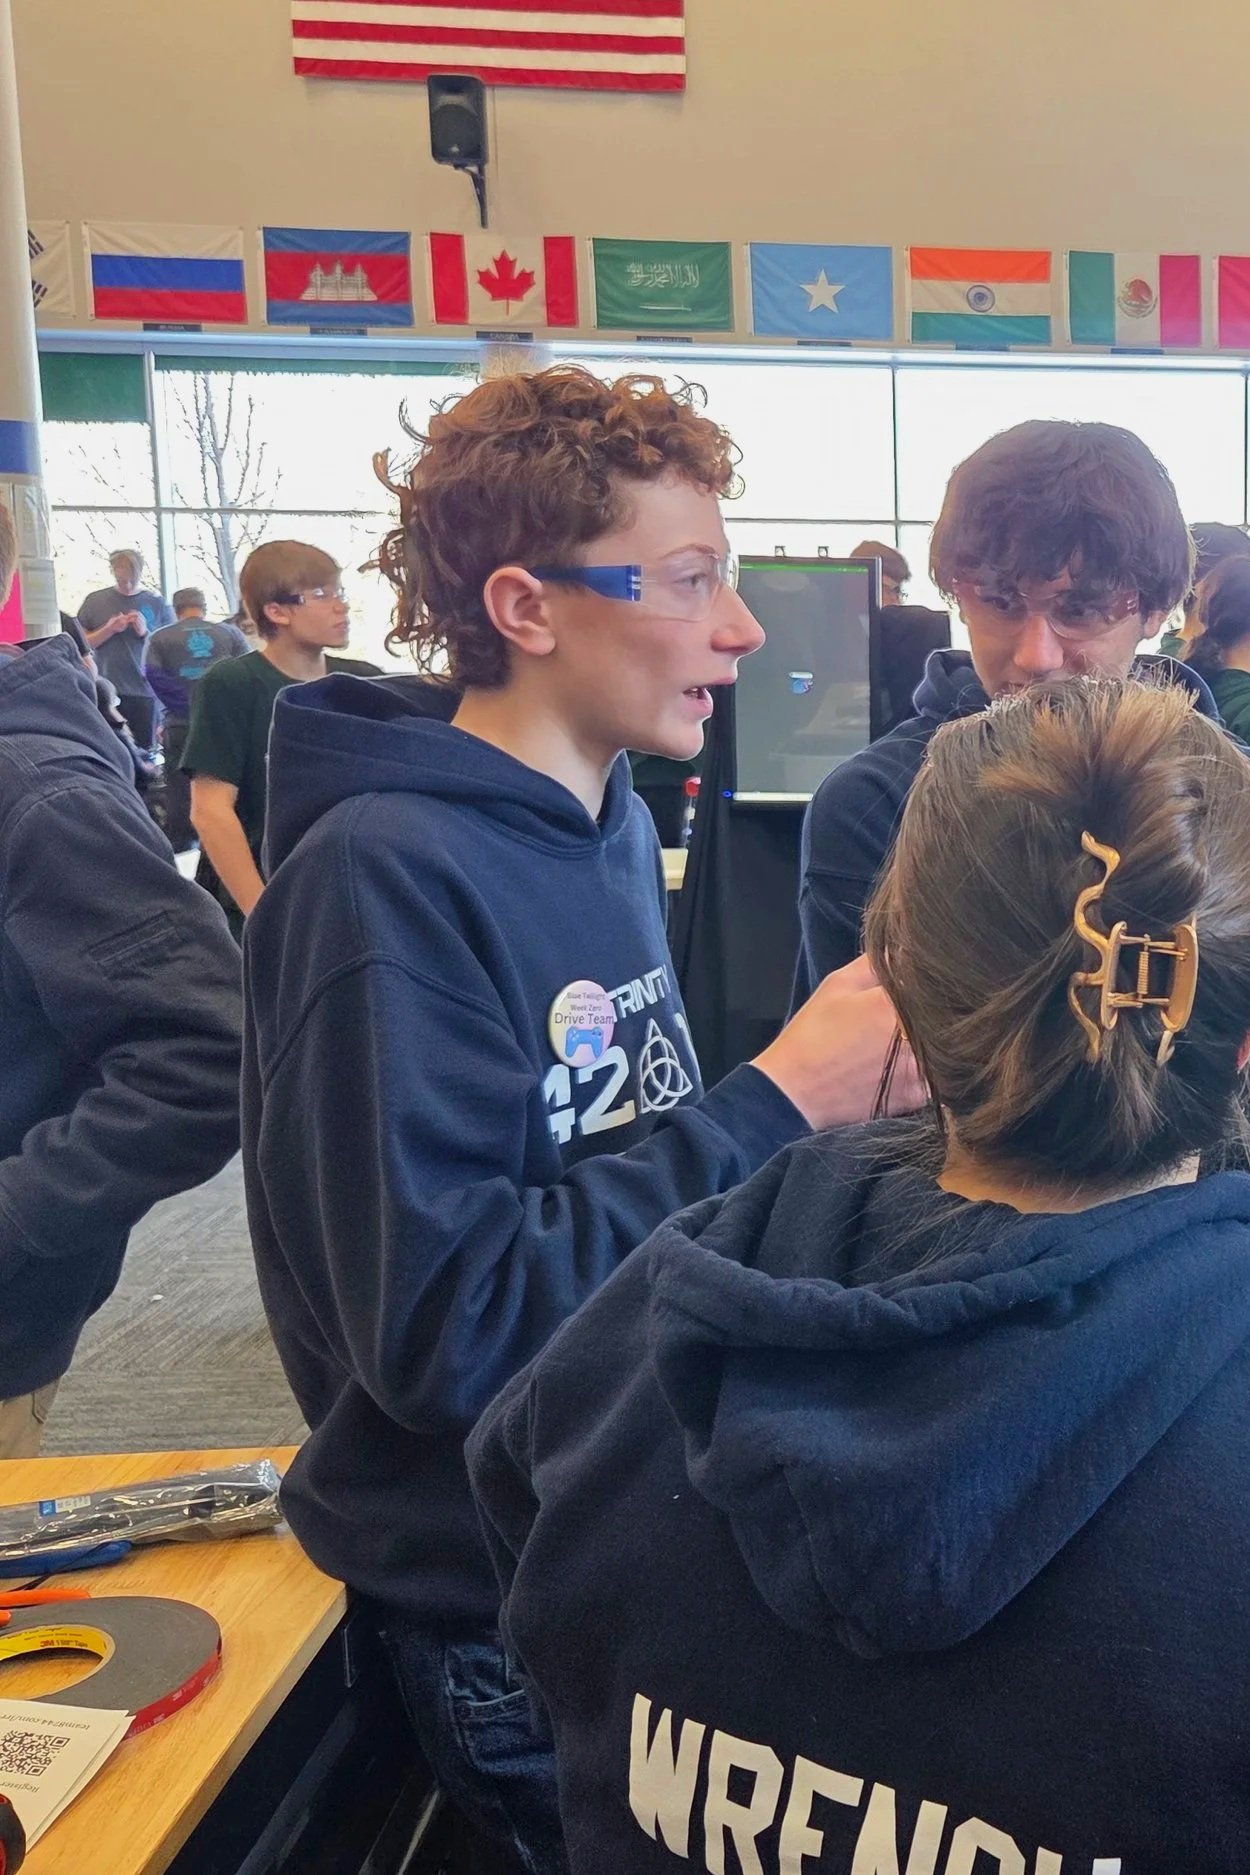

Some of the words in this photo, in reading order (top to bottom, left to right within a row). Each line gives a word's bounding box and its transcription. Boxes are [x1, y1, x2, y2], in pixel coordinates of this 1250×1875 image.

[554, 1012, 585, 1024] Drive
[587, 1013, 614, 1024] Team
[607, 964, 671, 1023] TRINITY
[543, 1046, 636, 1144] 42
[629, 1692, 1122, 1875] WREN
